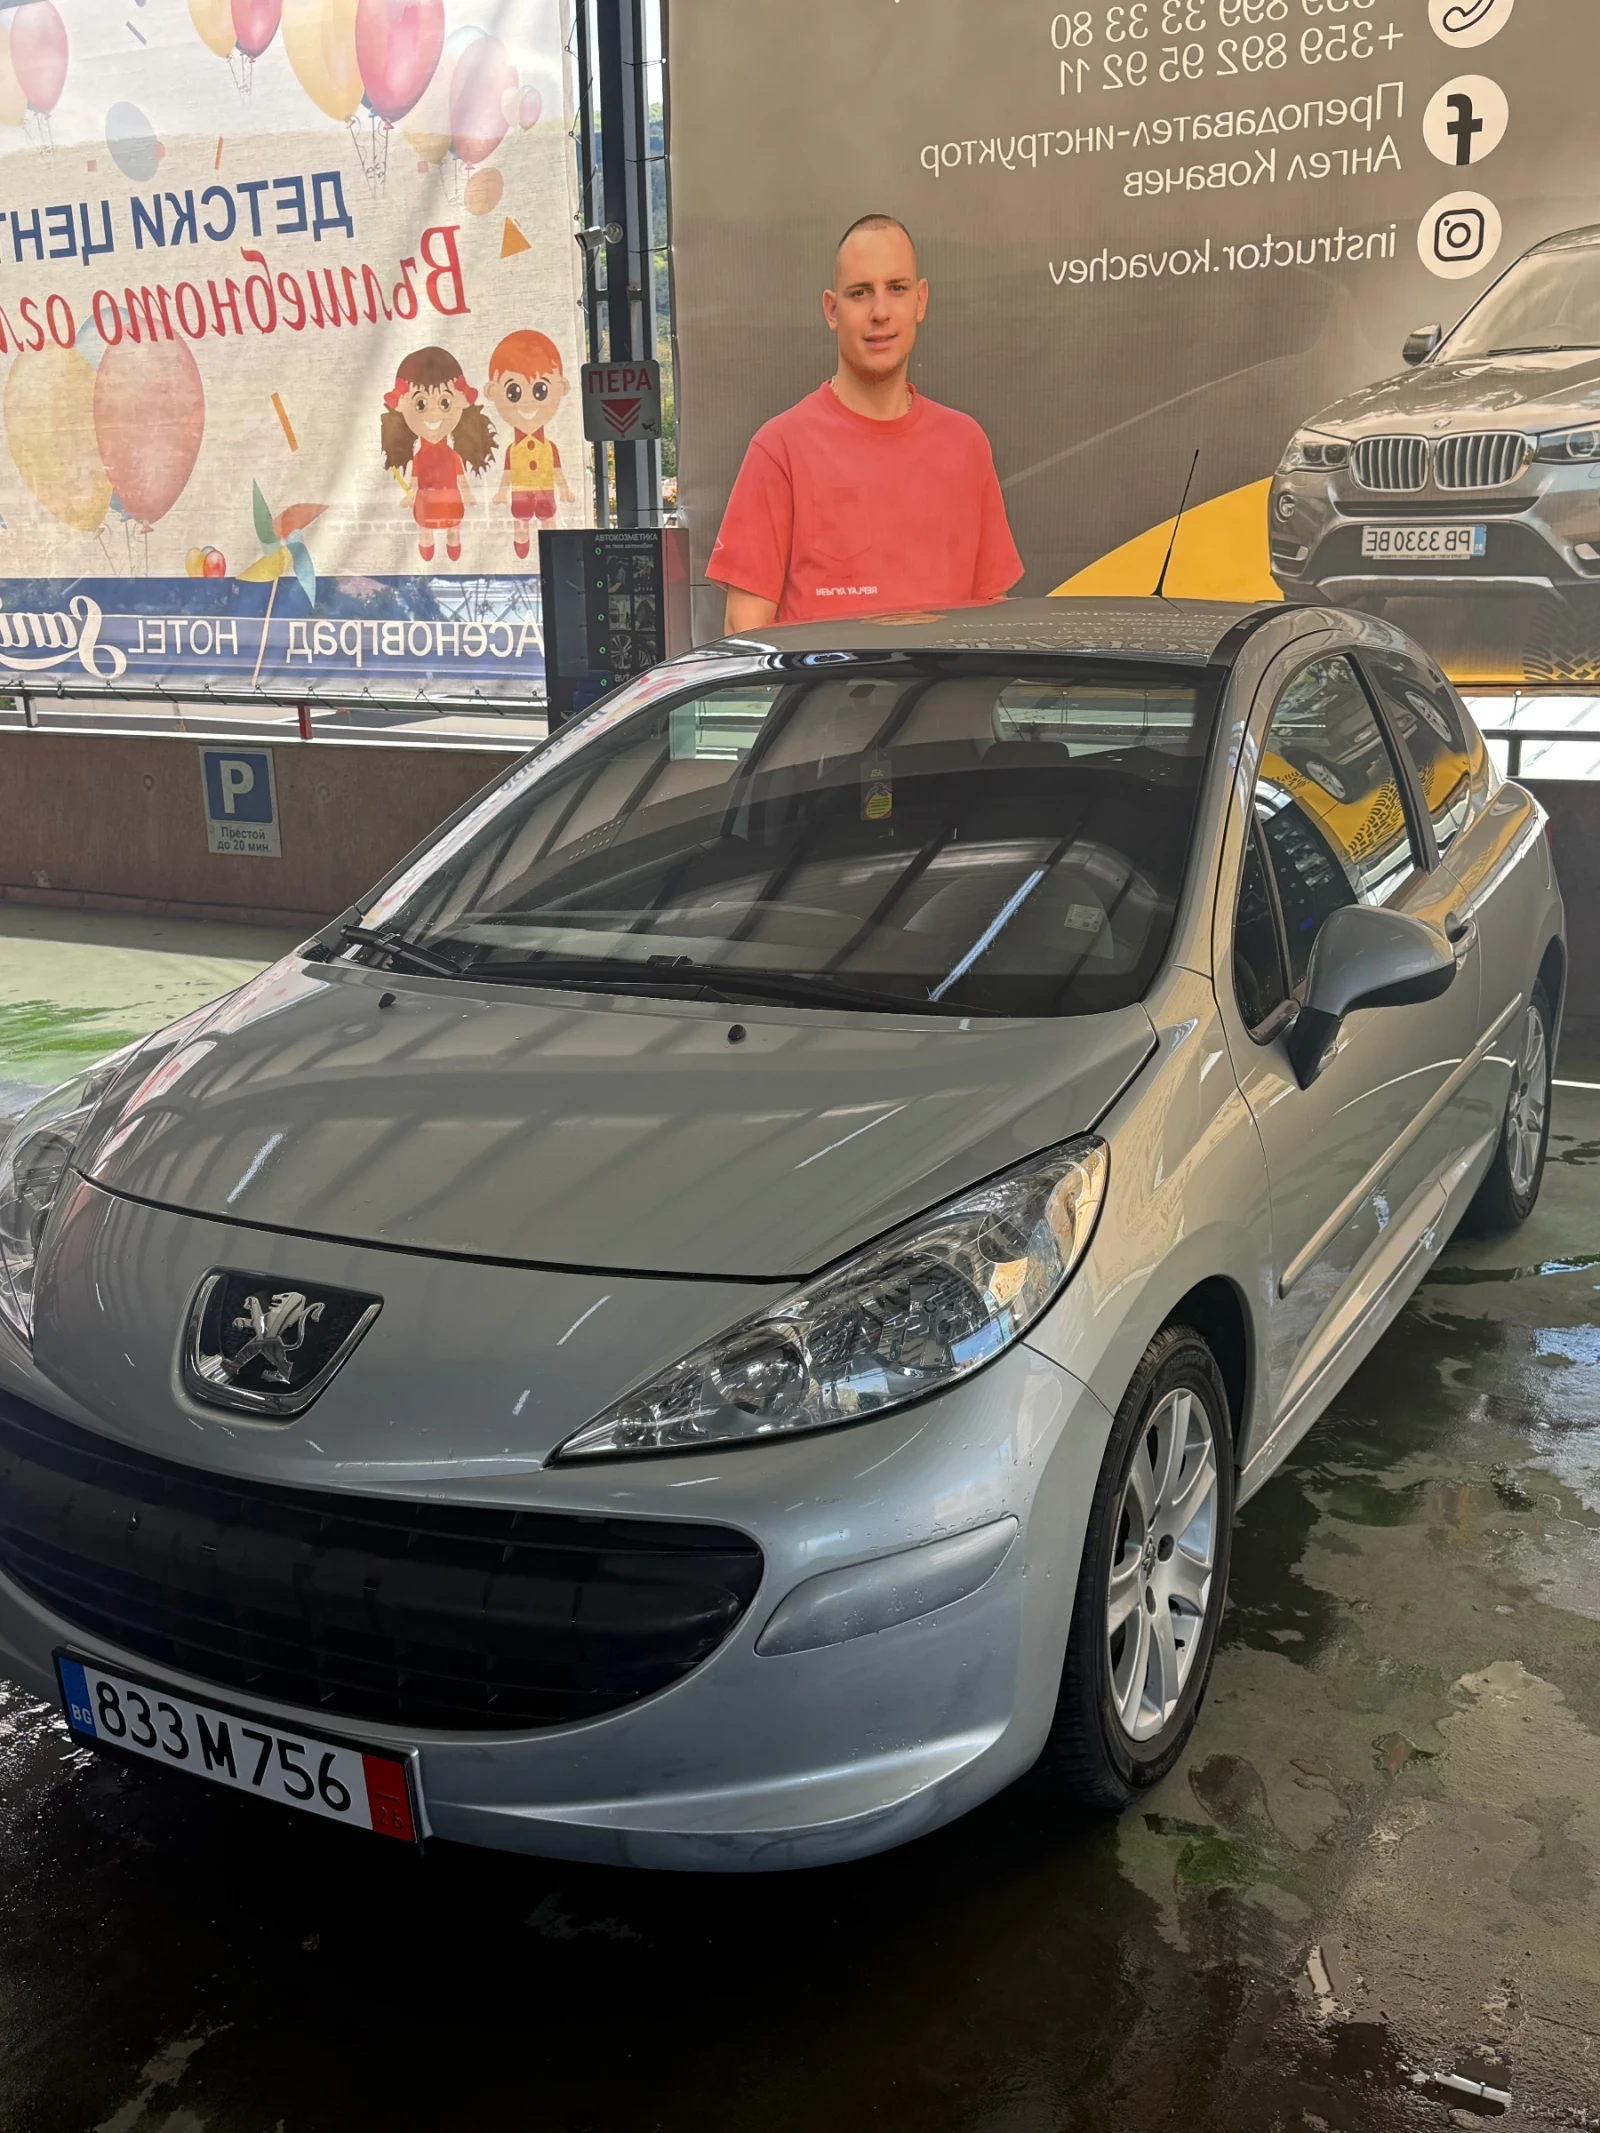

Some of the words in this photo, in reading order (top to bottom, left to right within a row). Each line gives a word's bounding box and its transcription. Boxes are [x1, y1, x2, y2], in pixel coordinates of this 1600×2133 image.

[588, 367, 653, 394] ПЕРА
[220, 760, 254, 814] P
[221, 826, 265, 840] Престой
[217, 840, 230, 850] до
[233, 839, 245, 851] 20
[248, 843, 272, 853] мин.
[71, 1703, 93, 1725] BG
